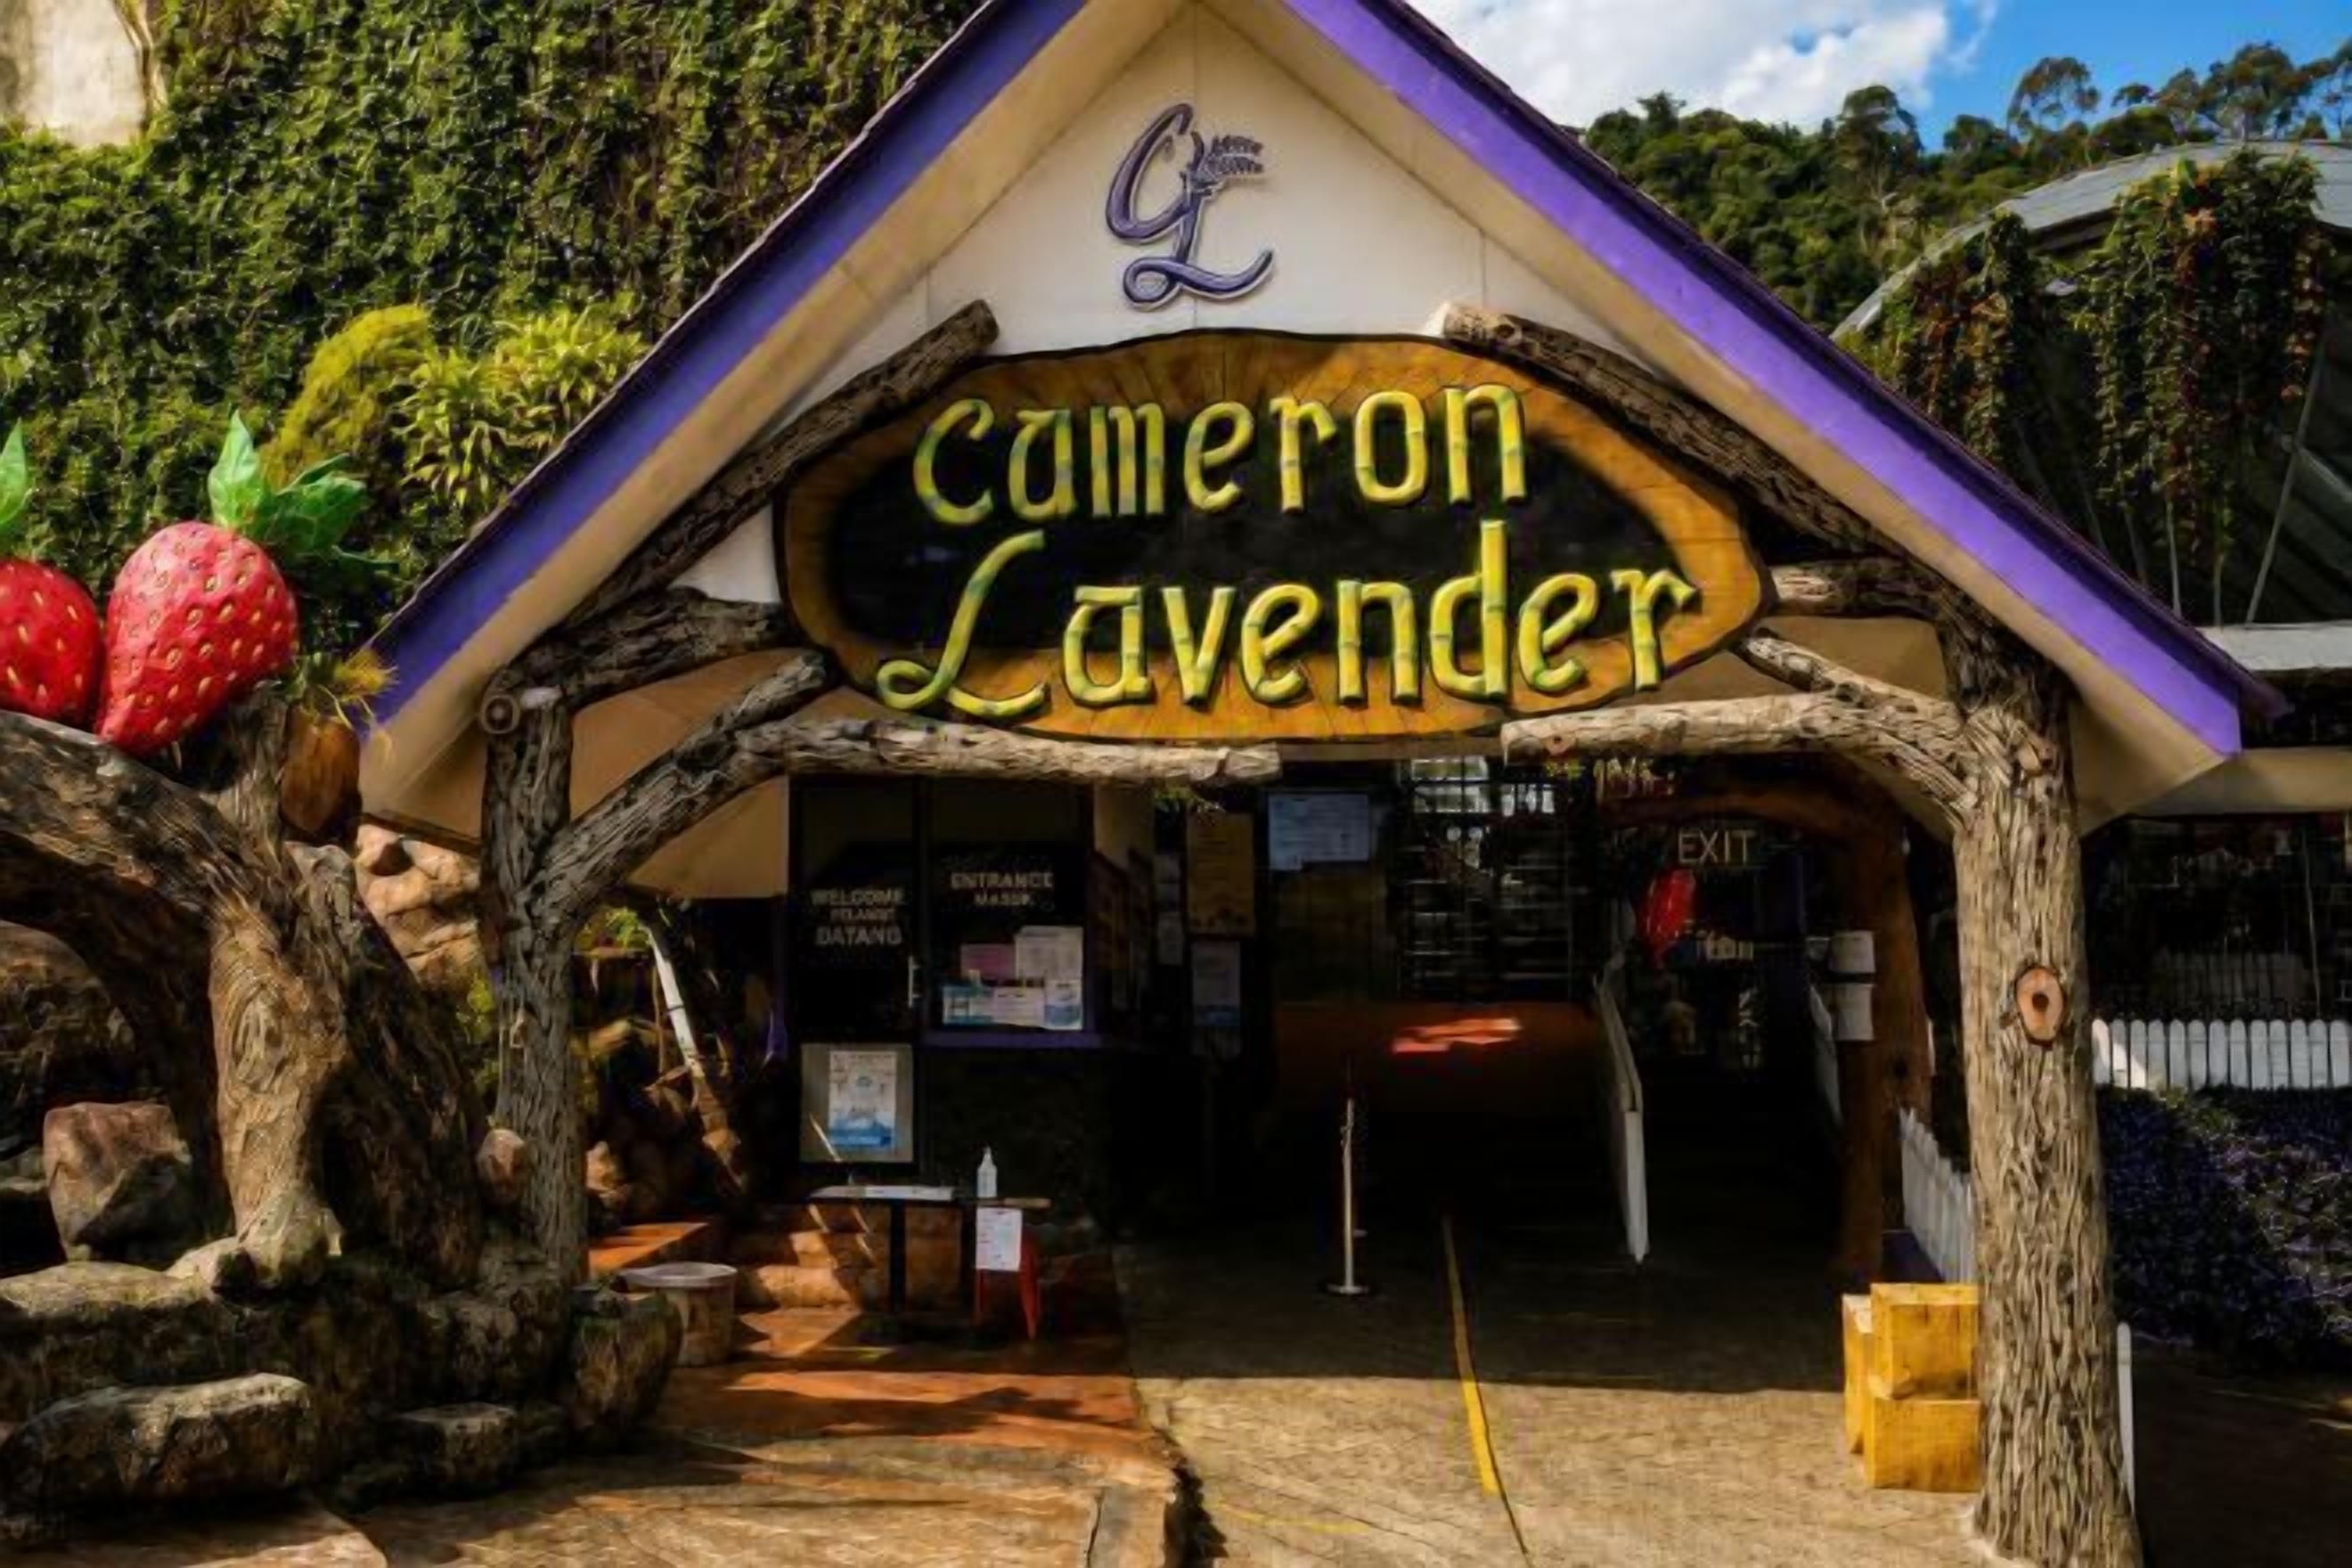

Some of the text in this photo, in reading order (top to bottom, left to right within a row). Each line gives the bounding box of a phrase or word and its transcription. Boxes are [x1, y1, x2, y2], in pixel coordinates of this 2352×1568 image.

[913, 382, 1527, 526] Cameron
[877, 519, 1699, 716] Lavender
[951, 871, 1055, 890] ENTRANCE
[1678, 829, 1757, 864] EXIT
